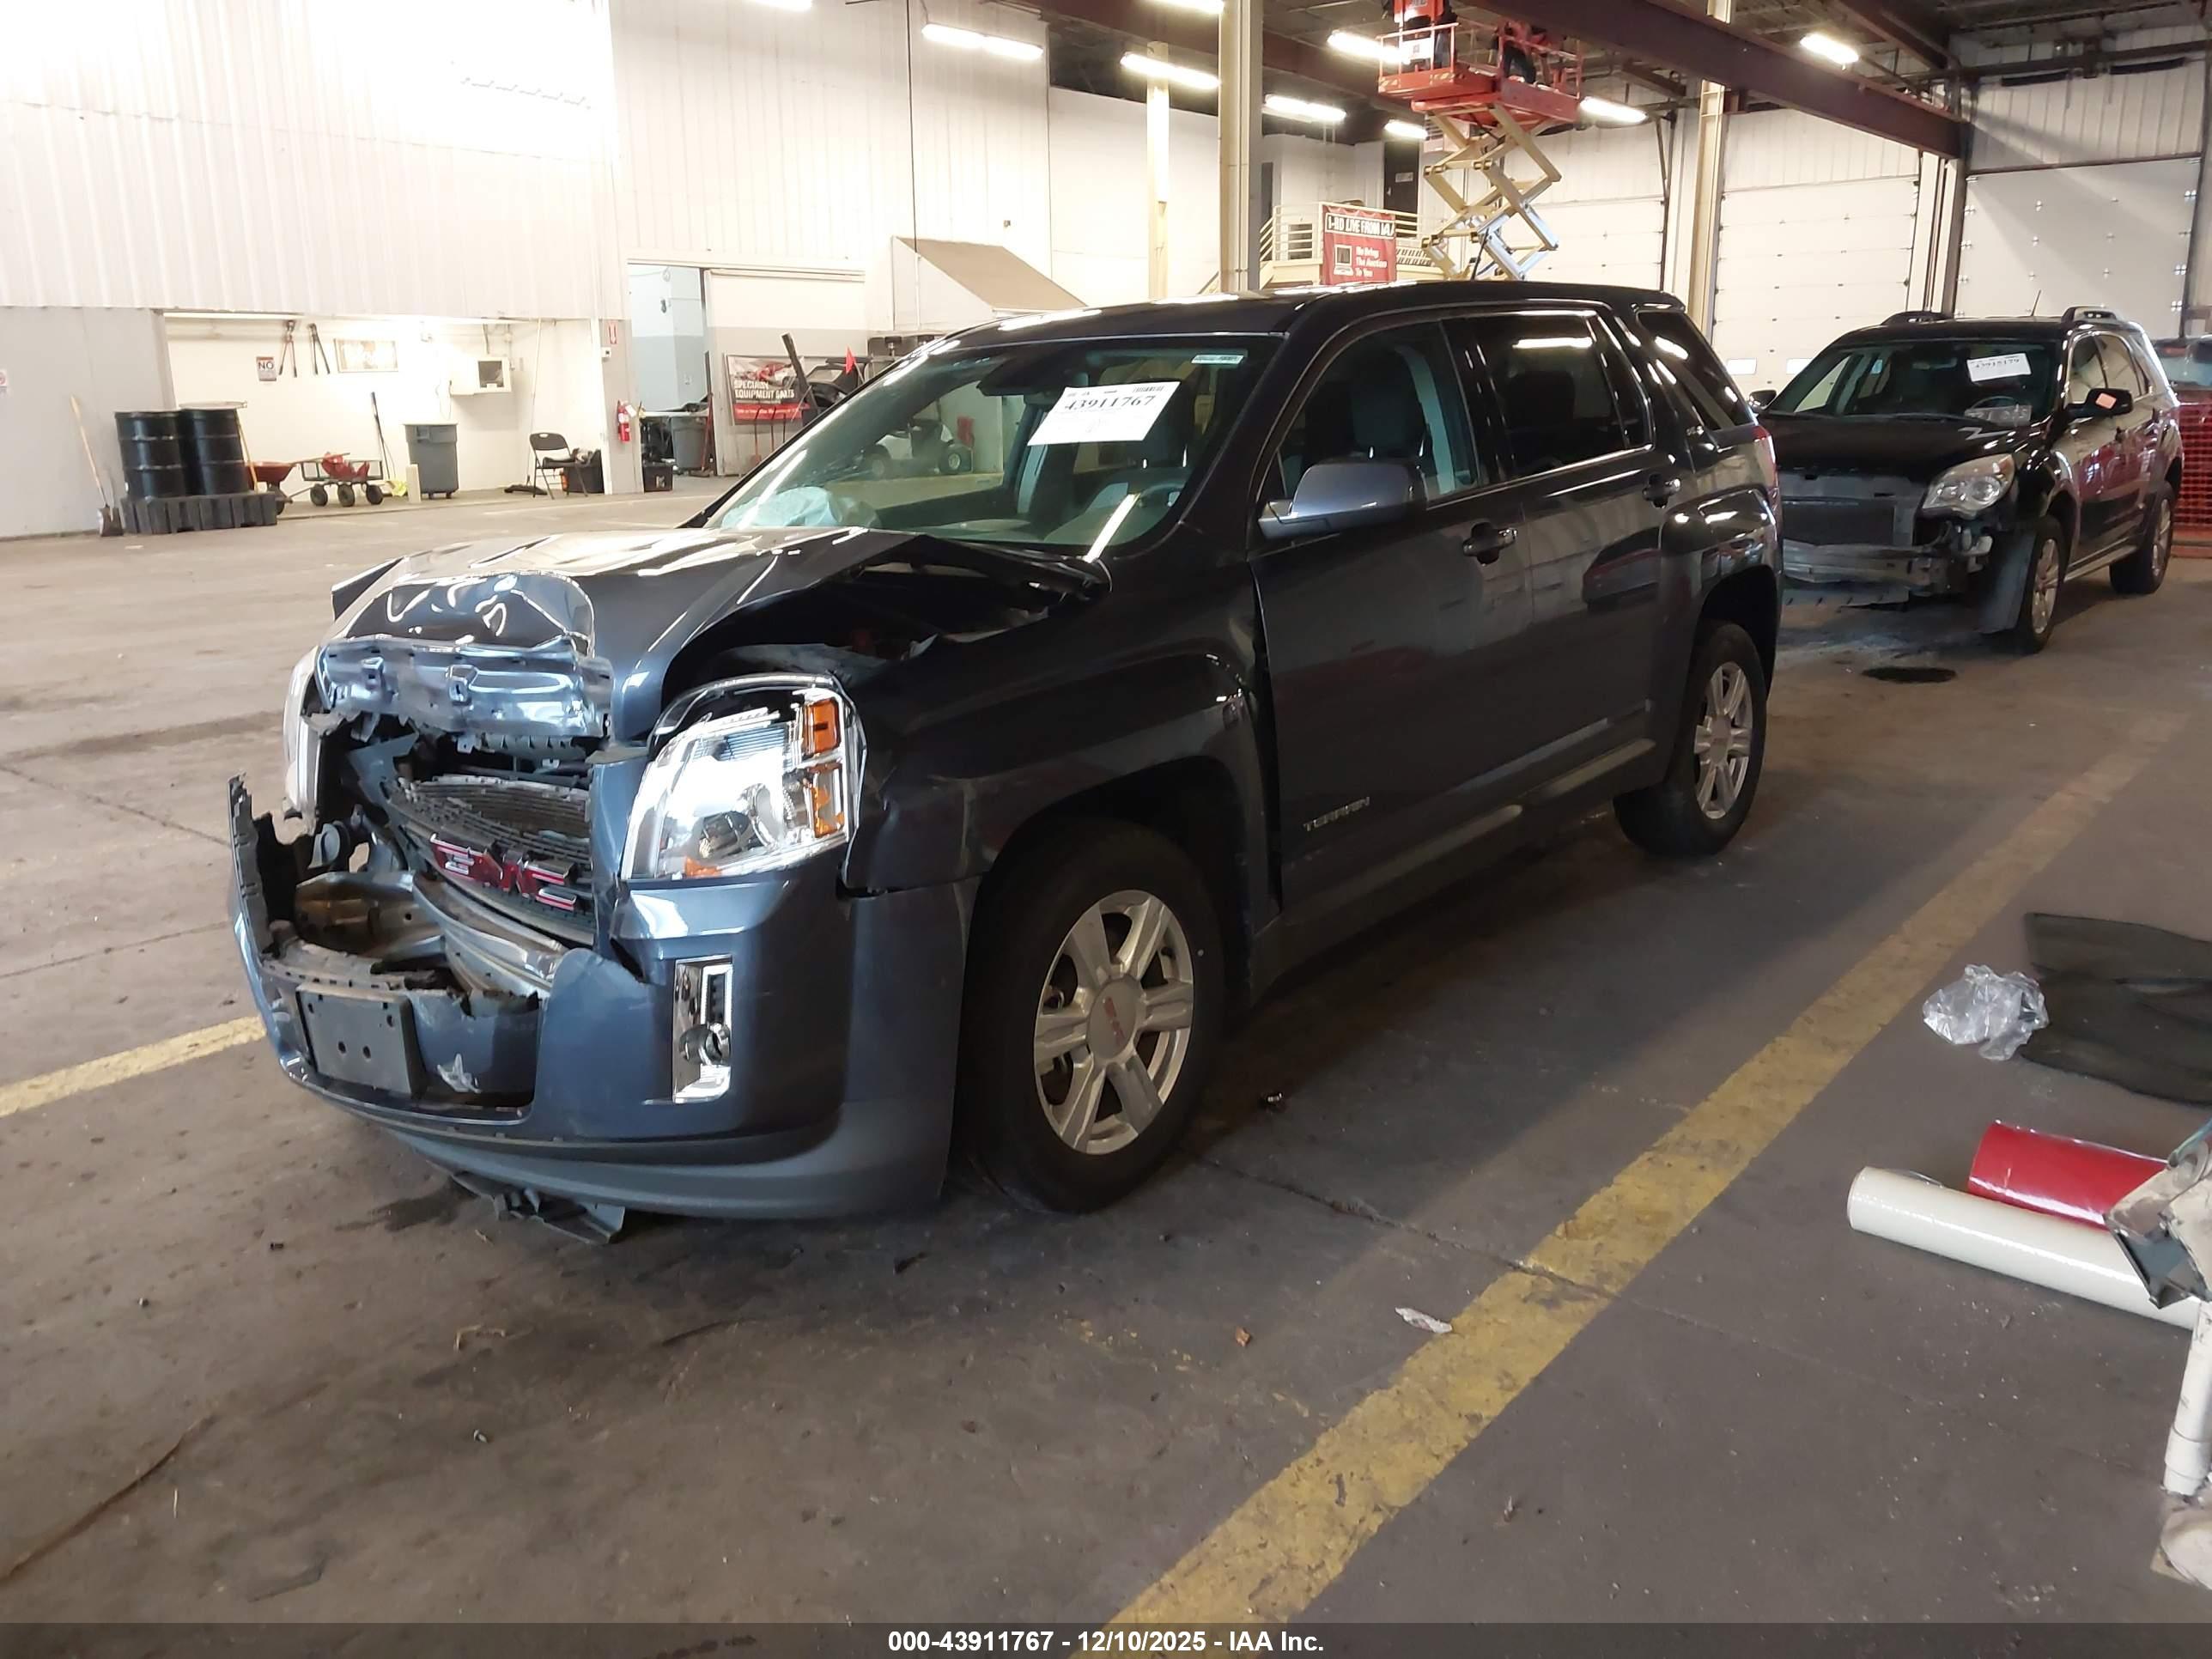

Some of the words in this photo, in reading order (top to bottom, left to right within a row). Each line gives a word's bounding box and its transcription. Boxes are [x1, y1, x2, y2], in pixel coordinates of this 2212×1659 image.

[1361, 220, 1380, 236] FROM
[258, 361, 274, 370] NO
[734, 389, 775, 399] EQUIPMENT
[1065, 395, 1156, 410] 43911767
